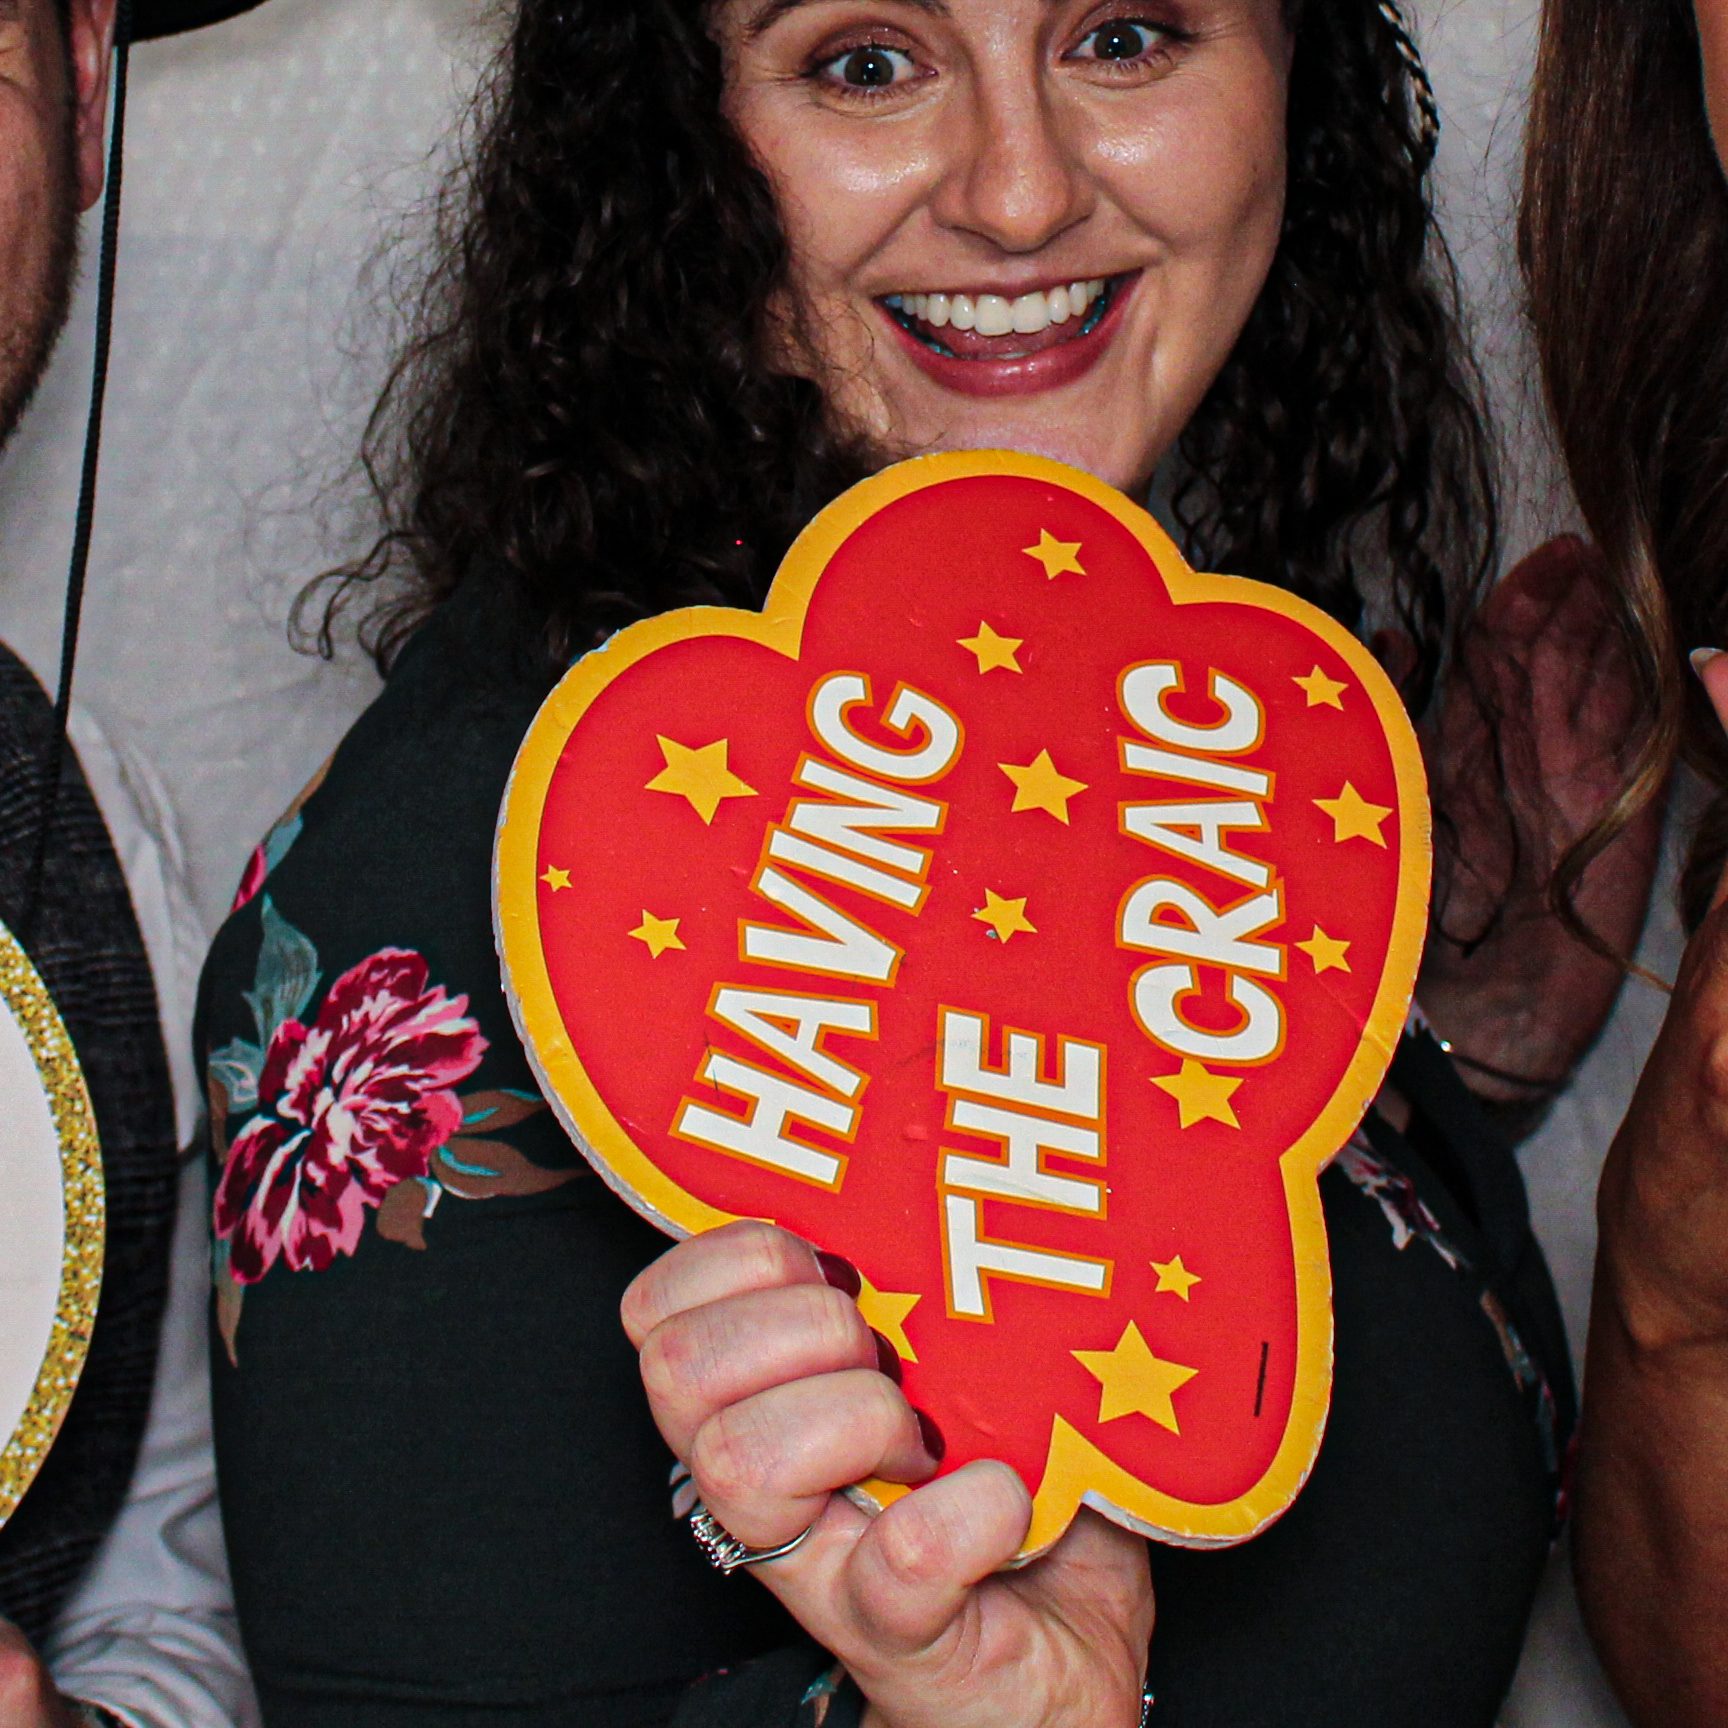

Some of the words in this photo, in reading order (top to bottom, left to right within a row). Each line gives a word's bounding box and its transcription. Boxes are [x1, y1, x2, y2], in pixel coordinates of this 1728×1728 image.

[669, 669, 964, 1193] HAVING
[1117, 660, 1287, 1067] CRAIC
[936, 1005, 1114, 1324] THE
